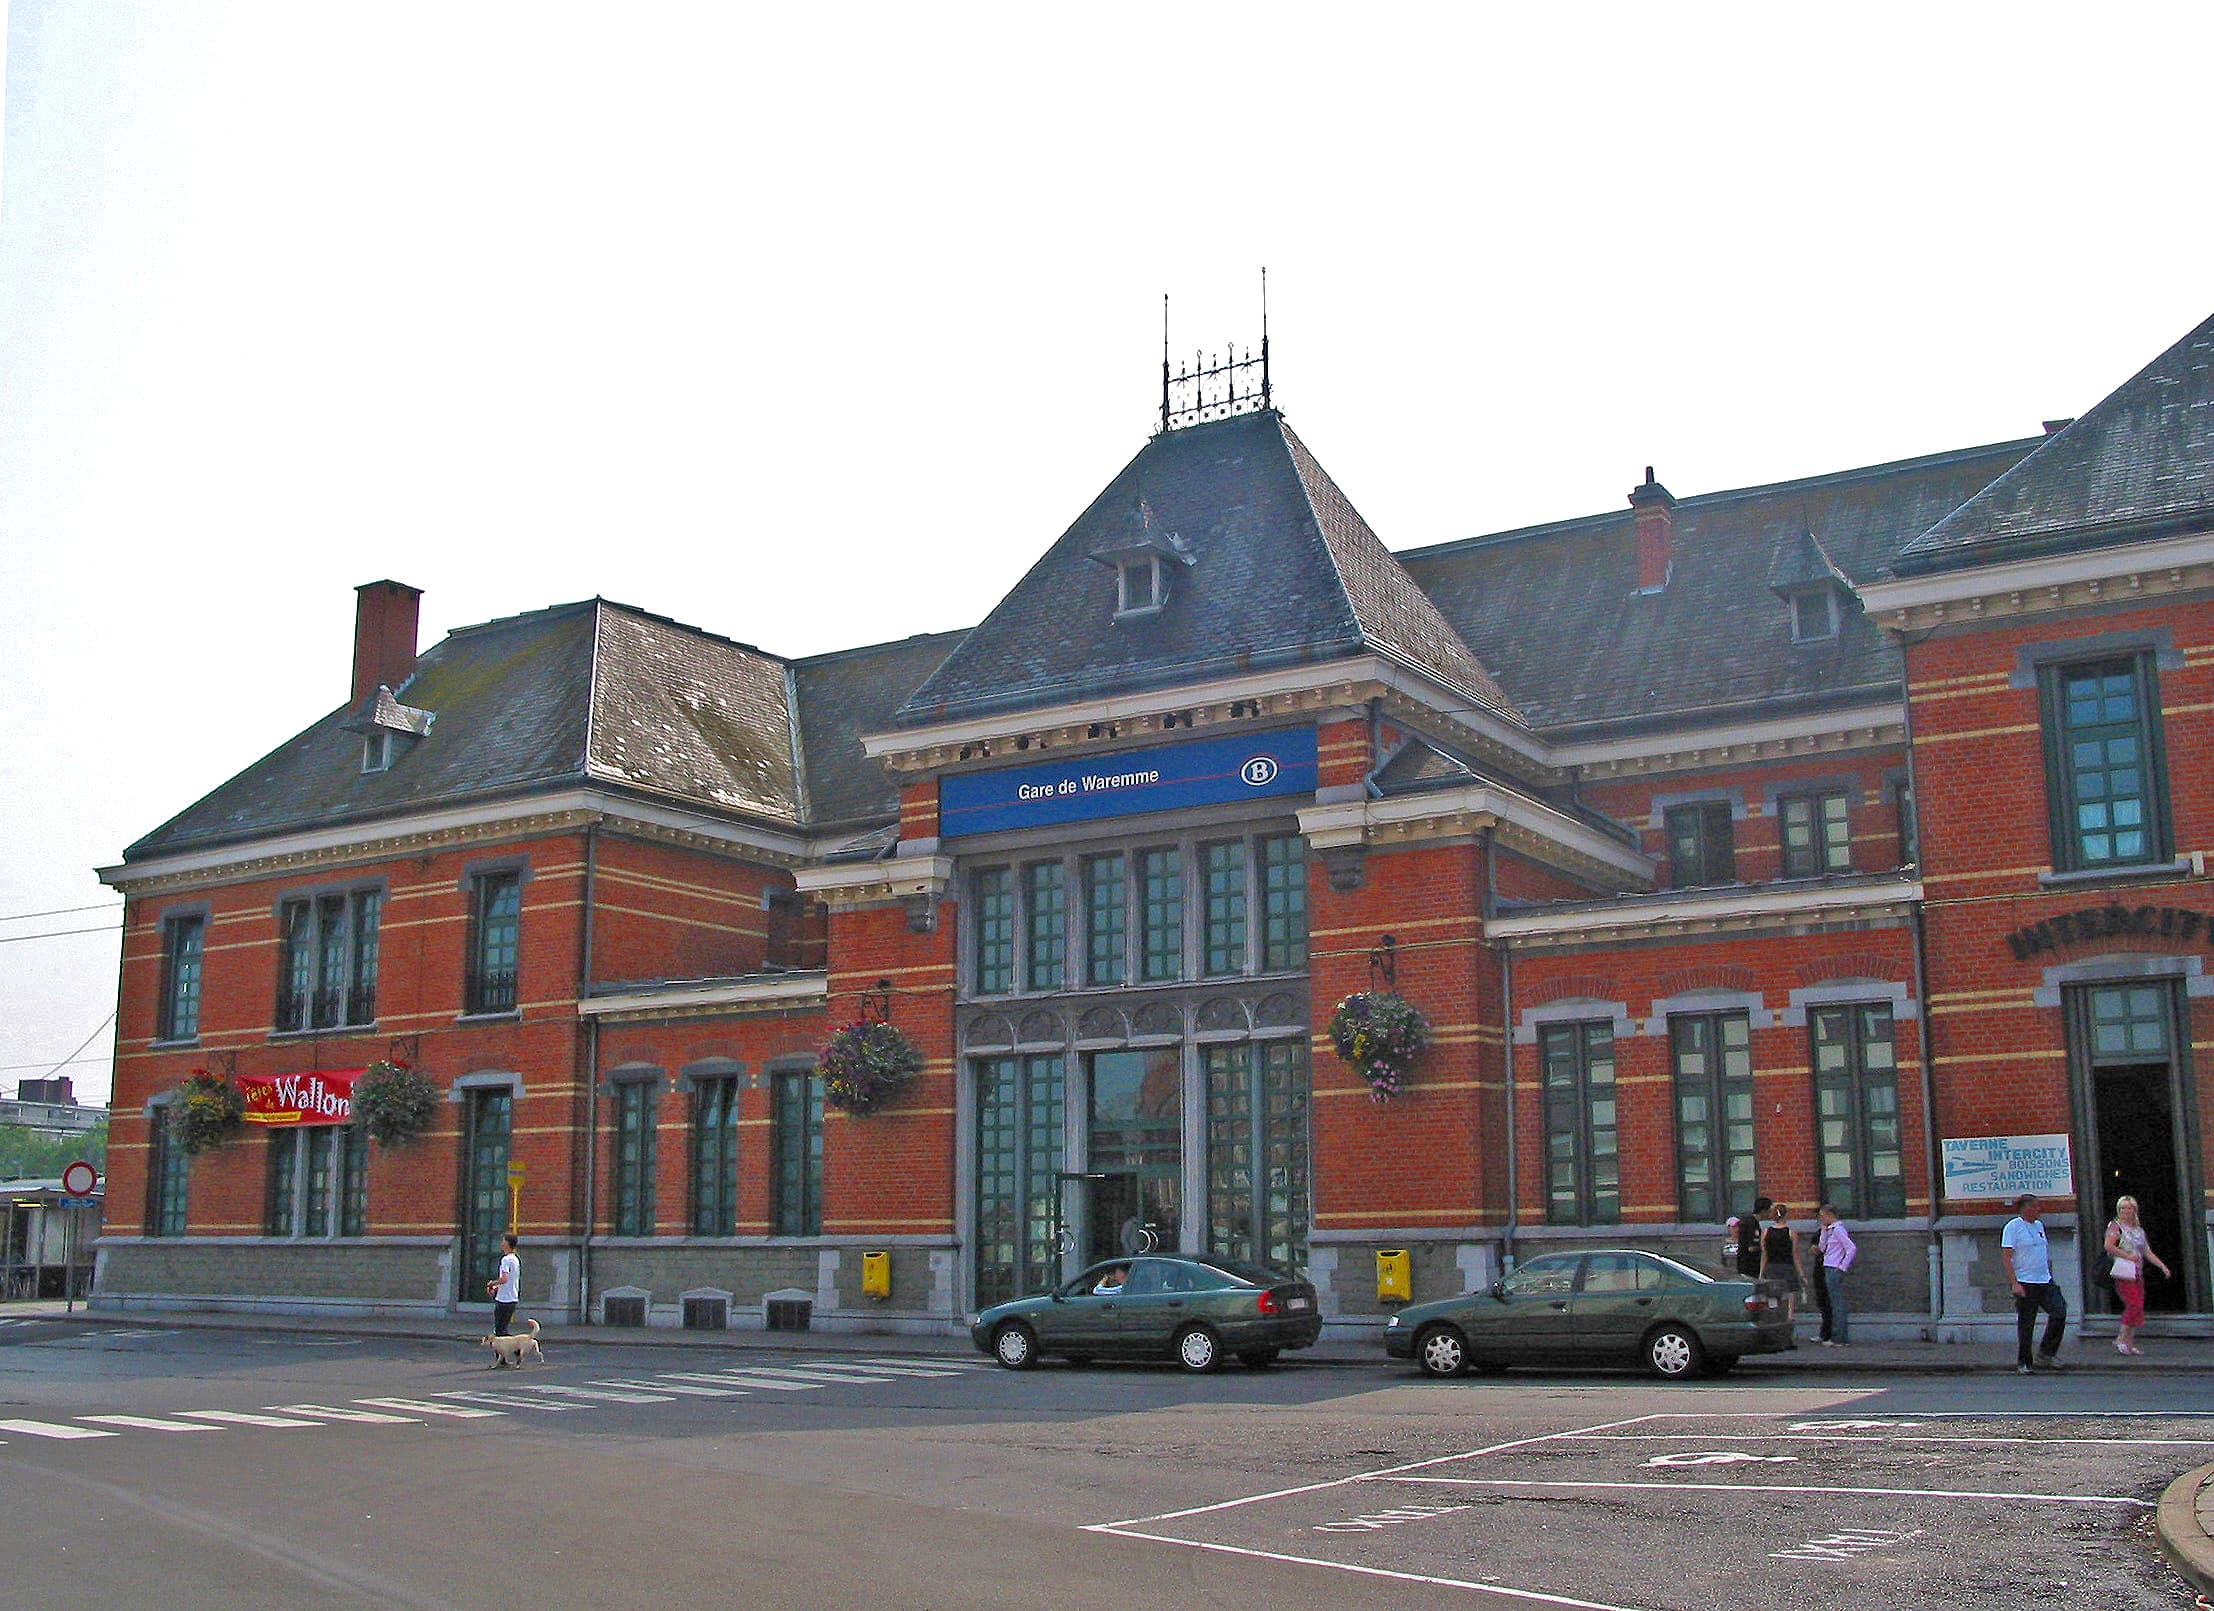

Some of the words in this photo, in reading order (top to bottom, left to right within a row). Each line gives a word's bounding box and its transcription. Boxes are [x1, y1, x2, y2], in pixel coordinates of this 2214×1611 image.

[1017, 783, 1054, 800] Gare
[1057, 780, 1077, 794] de
[1081, 769, 1160, 792] Waremme
[274, 1075, 354, 1117] Wallon
[1942, 1138, 2009, 1152] TAVERNE
[1988, 1147, 2067, 1161] INTERCITY
[2008, 1158, 2069, 1169] BOISSONS
[1990, 1168, 2070, 1181] SANDWICHES
[1962, 1180, 2052, 1193] RESTAURATION
